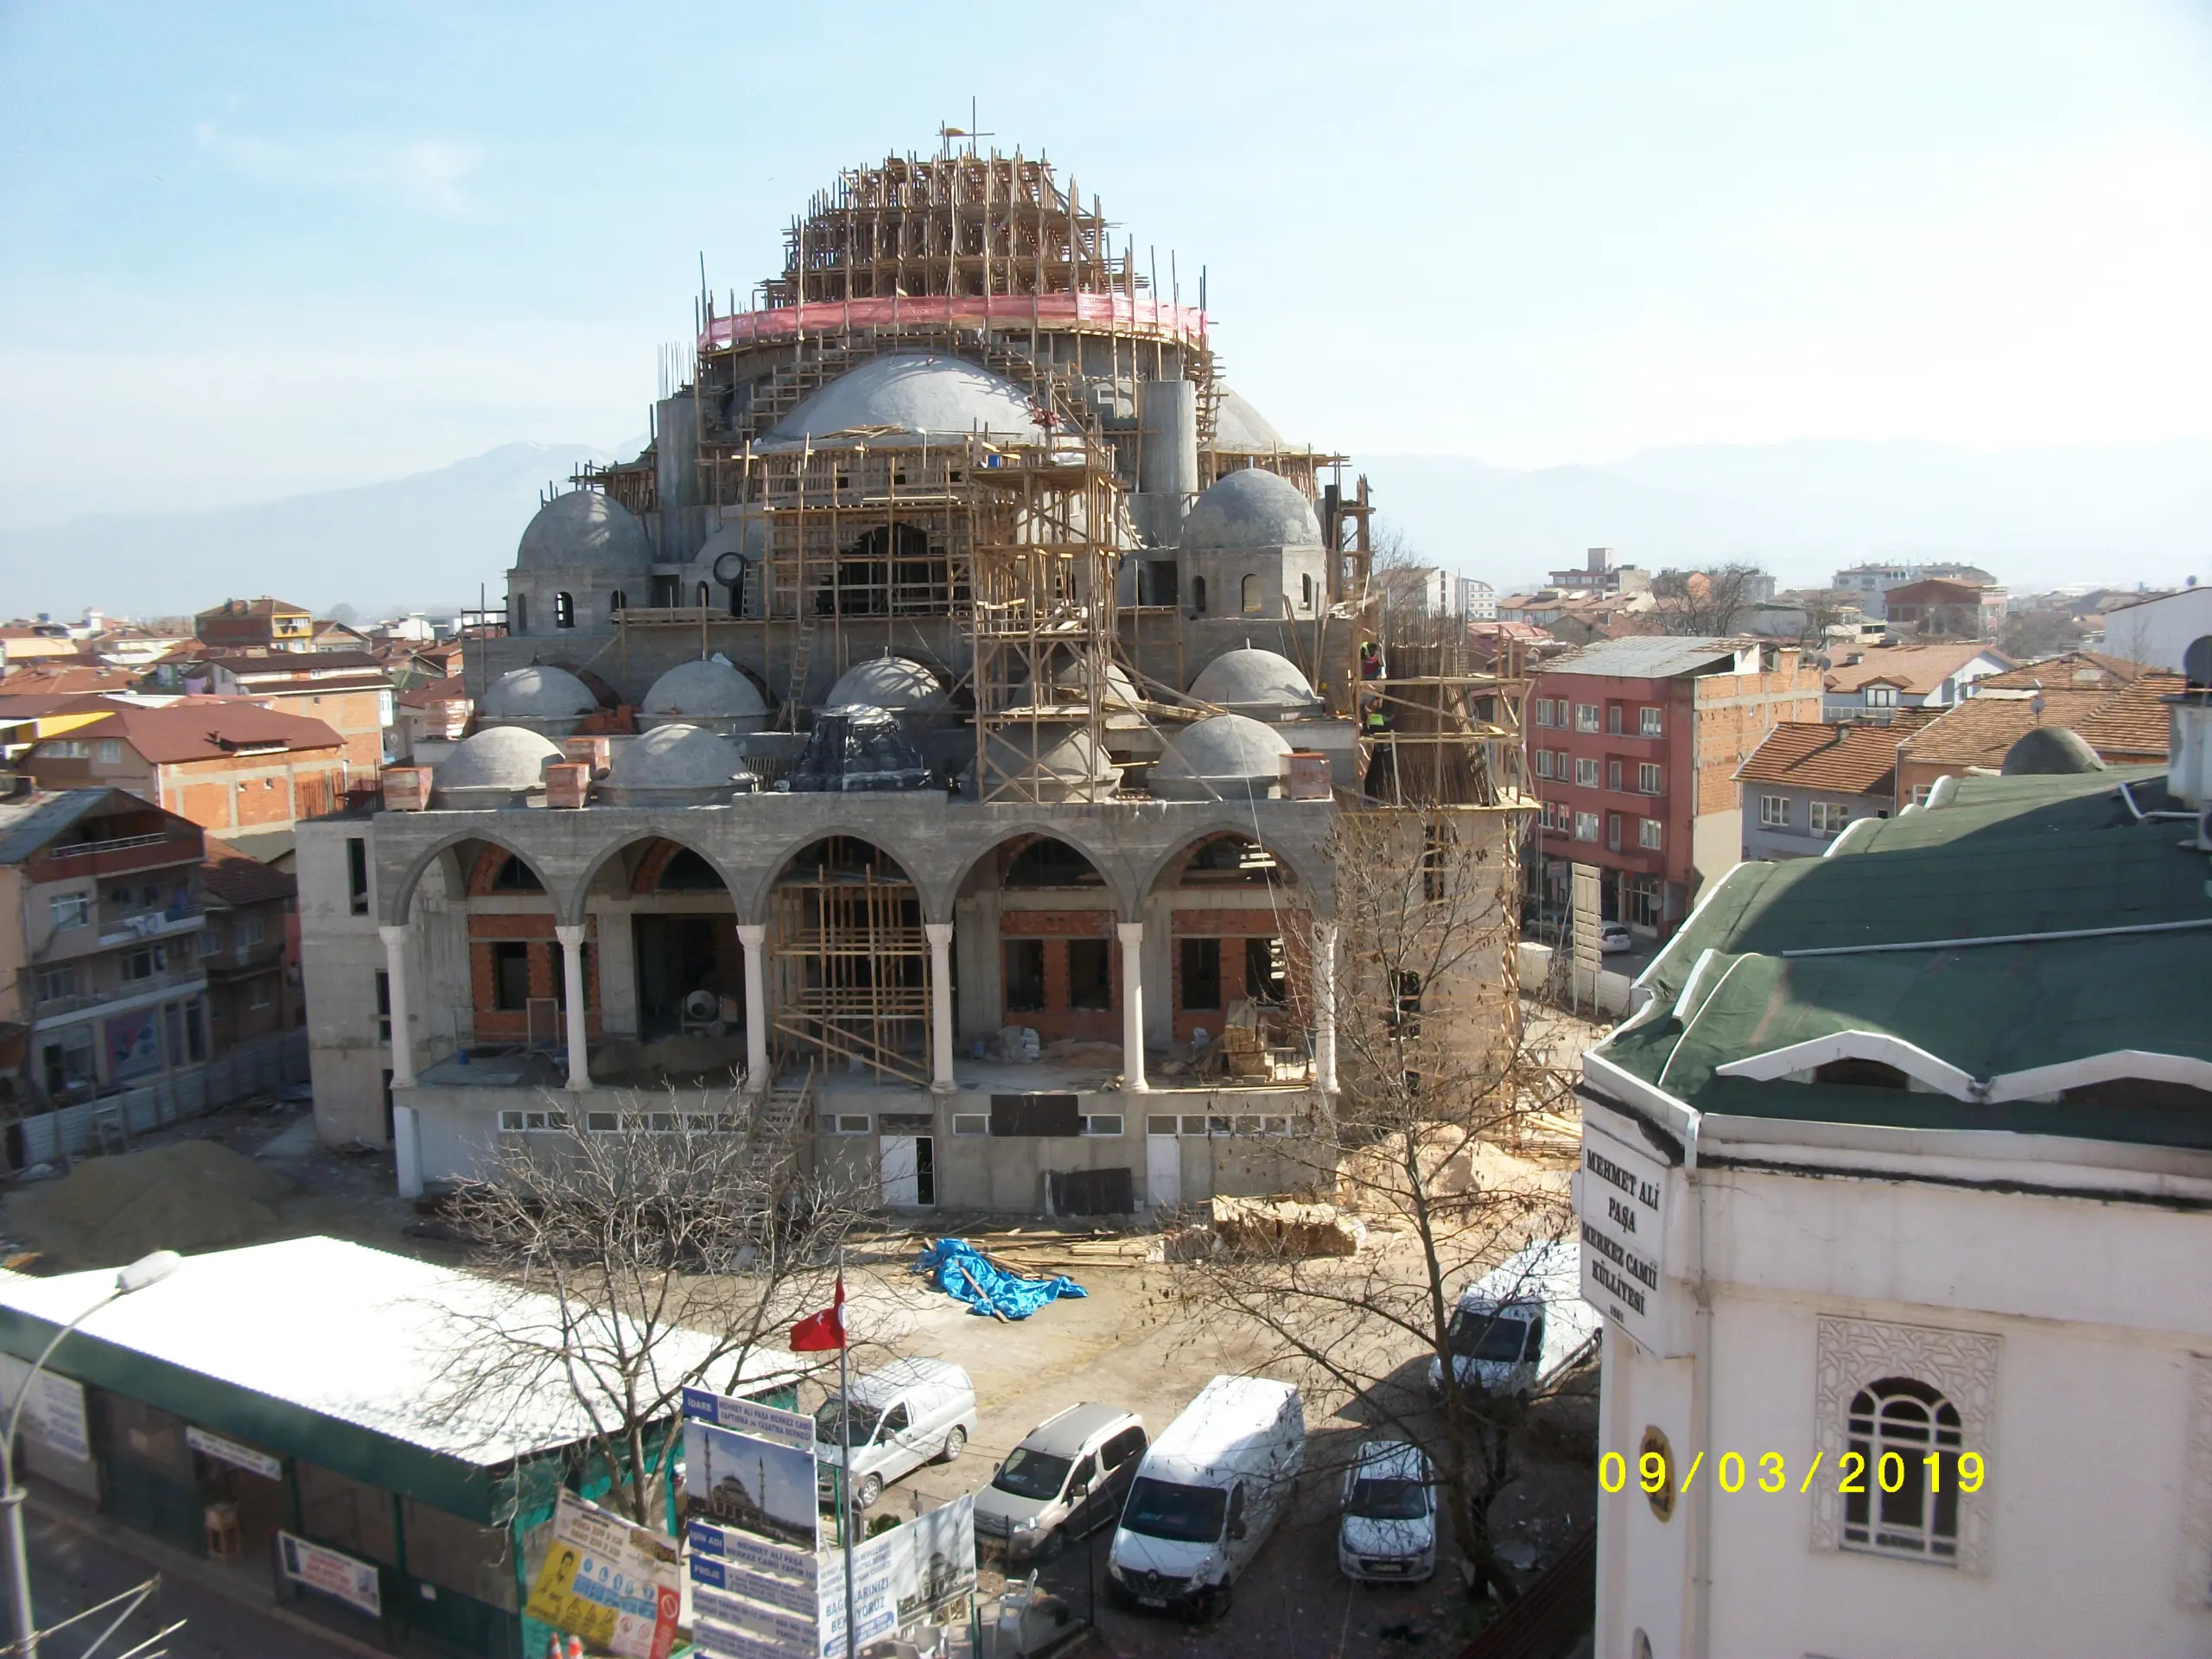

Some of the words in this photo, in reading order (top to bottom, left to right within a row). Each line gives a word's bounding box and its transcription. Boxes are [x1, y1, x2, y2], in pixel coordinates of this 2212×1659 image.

[1586, 1149, 1637, 1197] MEHMET
[1638, 1182, 1660, 1211] ALİ
[1609, 1198, 1637, 1234] PAŞA
[1583, 1222, 1624, 1266] MERKEZ
[1625, 1253, 1658, 1291] CAMİİ
[1592, 1260, 1645, 1316] KÜLLİYESİ
